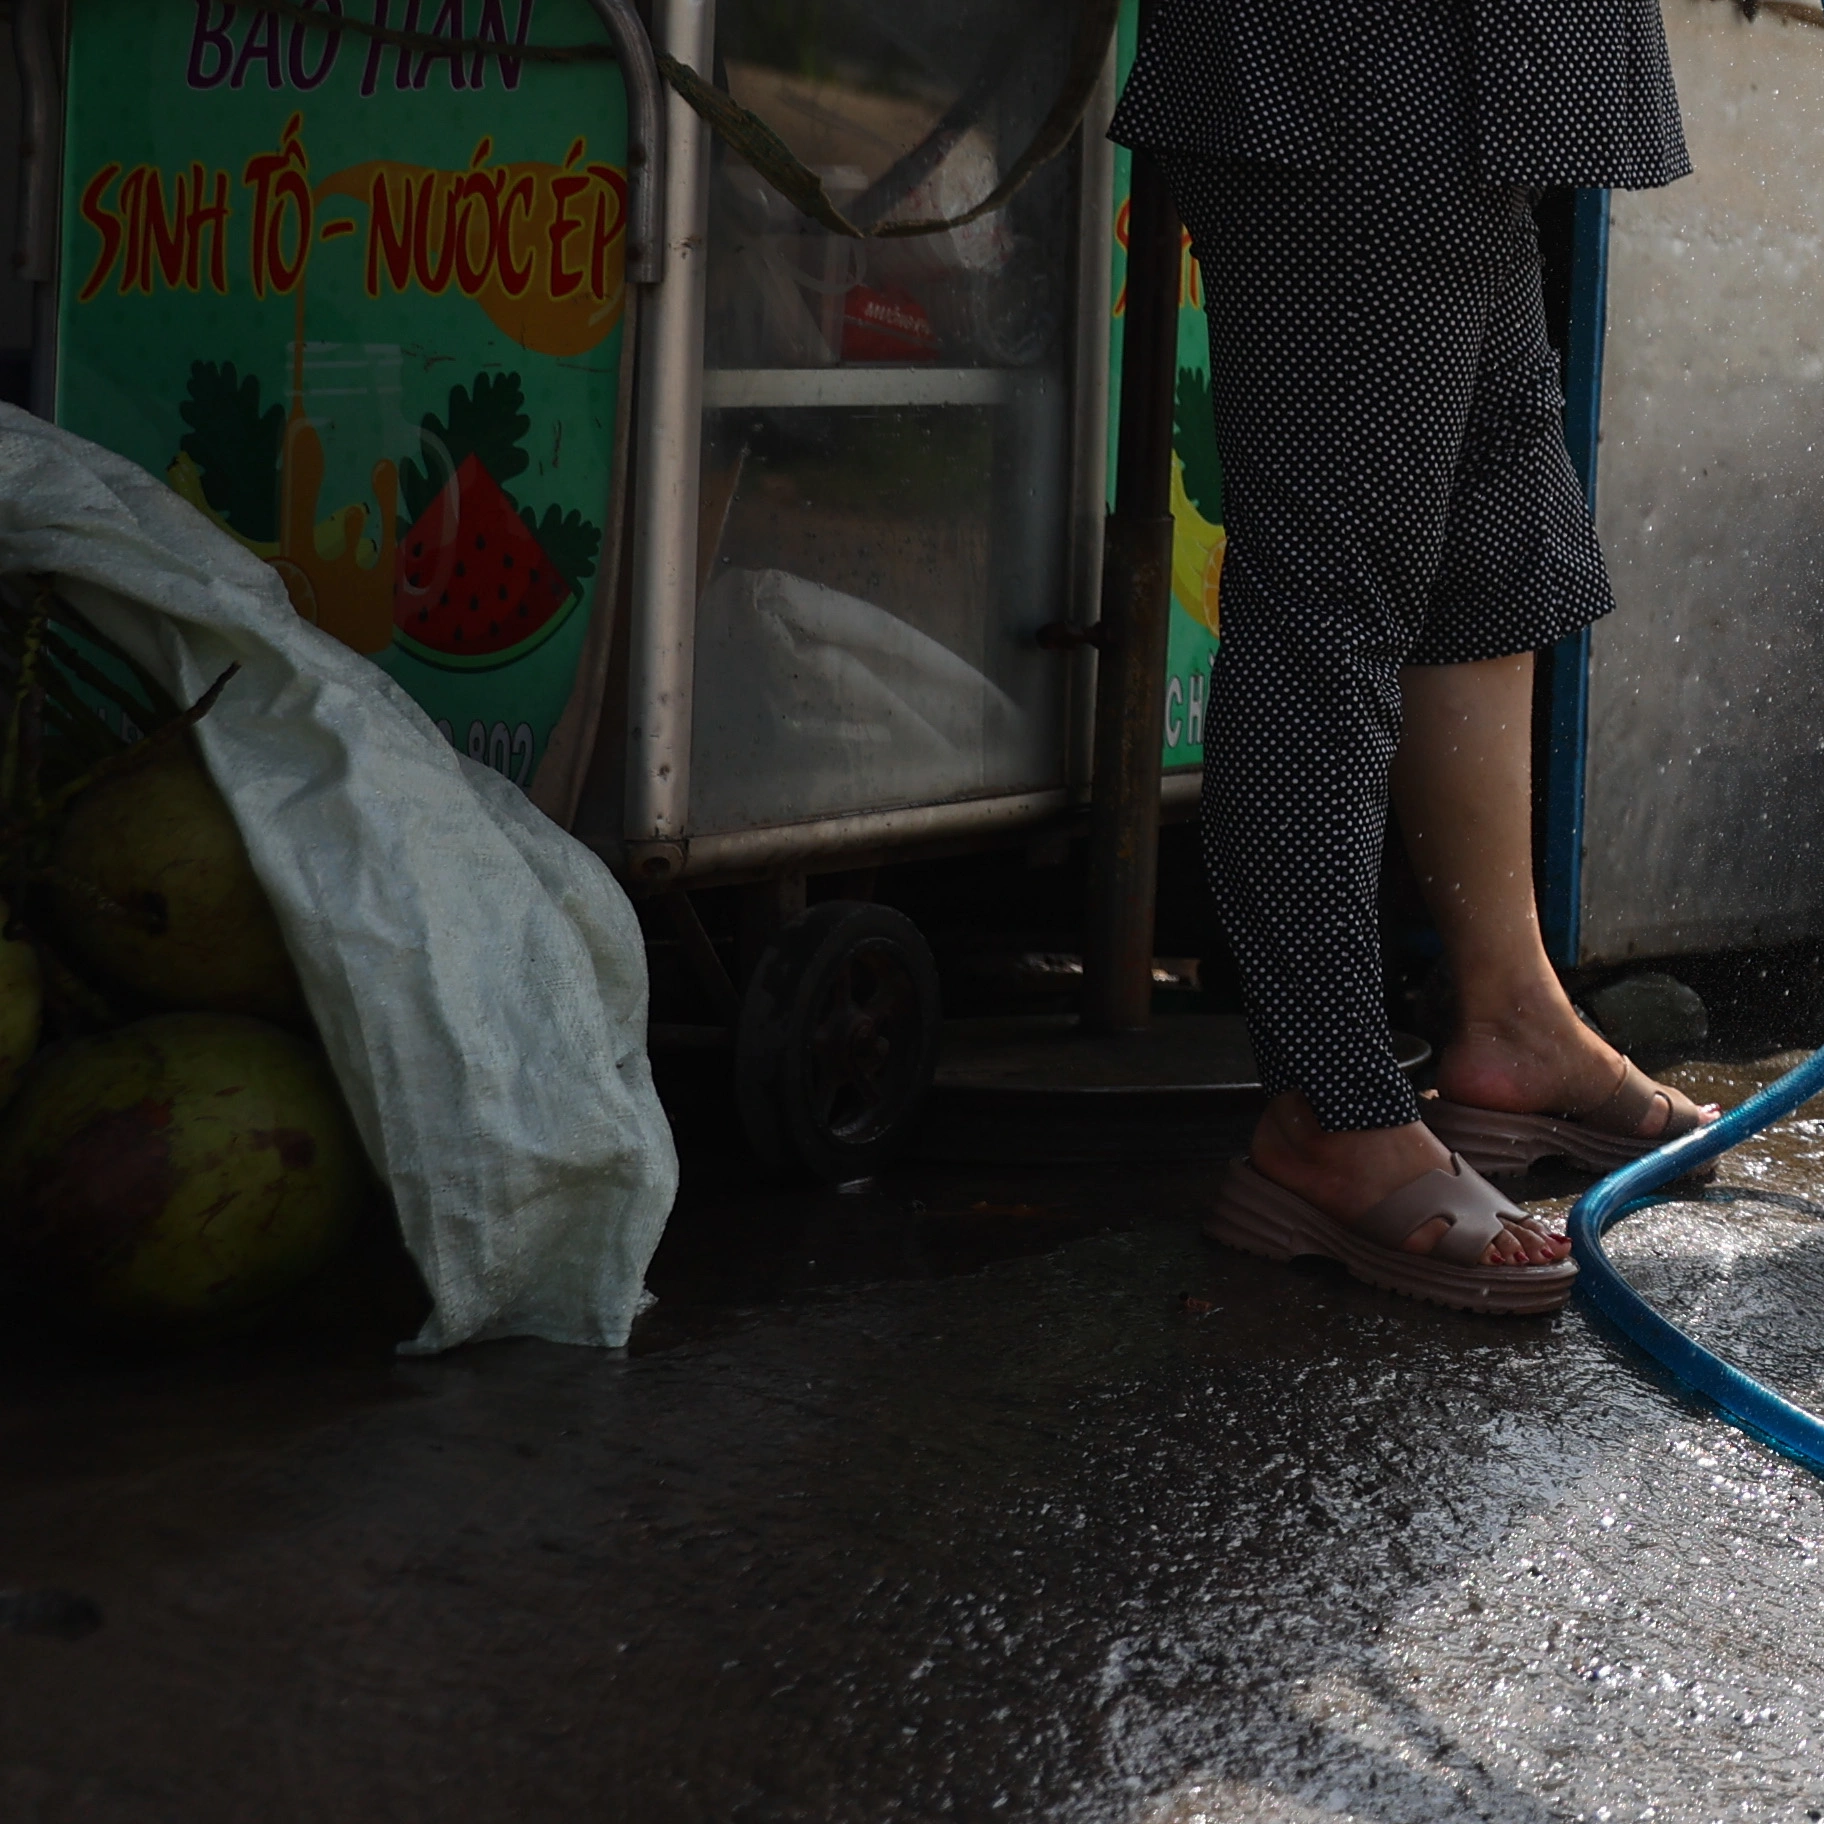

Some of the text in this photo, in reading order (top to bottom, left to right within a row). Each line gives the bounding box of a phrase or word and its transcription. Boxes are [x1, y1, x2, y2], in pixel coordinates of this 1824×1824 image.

[77, 161, 230, 301] SINH
[244, 112, 311, 301] TỐ
[364, 136, 536, 299] NƯỚC
[546, 136, 627, 304] ÉP
